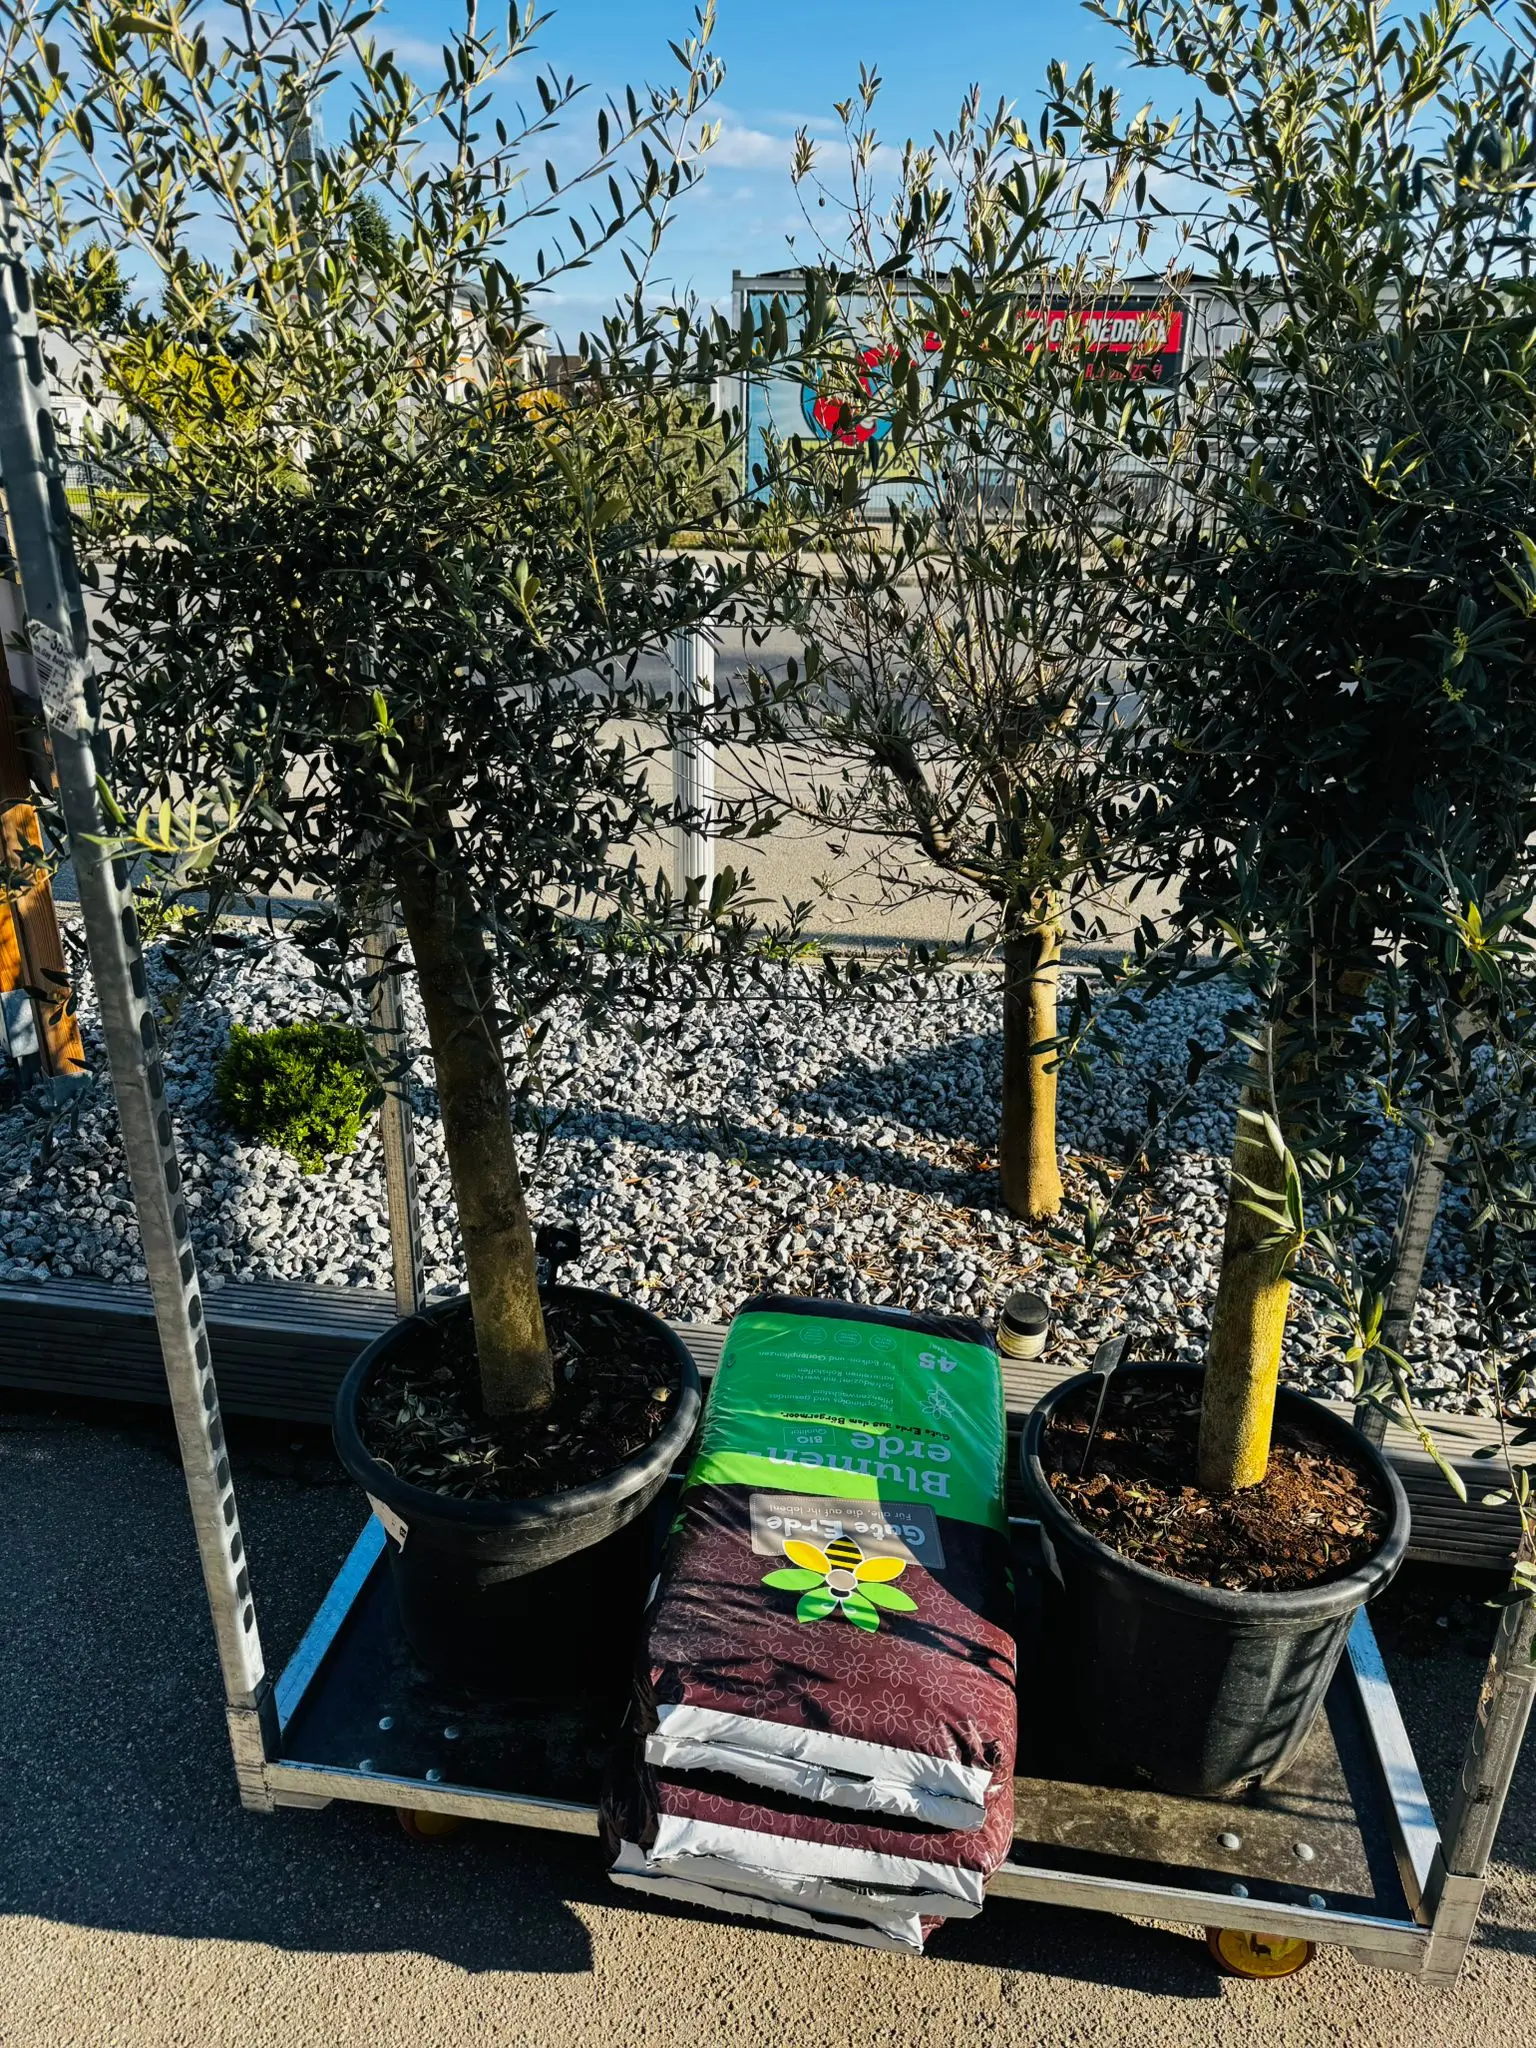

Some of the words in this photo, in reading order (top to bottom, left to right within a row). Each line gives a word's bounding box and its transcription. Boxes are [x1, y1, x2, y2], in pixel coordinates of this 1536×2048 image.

[918, 1351, 957, 1373] 45
[848, 1418, 870, 1427] dem
[872, 1421, 892, 1429] aus
[895, 1424, 921, 1435] Erde
[922, 1427, 951, 1441] Gute
[797, 1435, 823, 1444] BIO
[850, 1432, 951, 1463] erde
[746, 1447, 951, 1498] Blumen-
[806, 1507, 821, 1516] ihr
[824, 1508, 843, 1516] auf
[846, 1509, 863, 1518] die
[868, 1509, 890, 1519] alle,
[895, 1512, 912, 1521] Für
[766, 1516, 843, 1538] Erde
[855, 1521, 925, 1545] Gute
